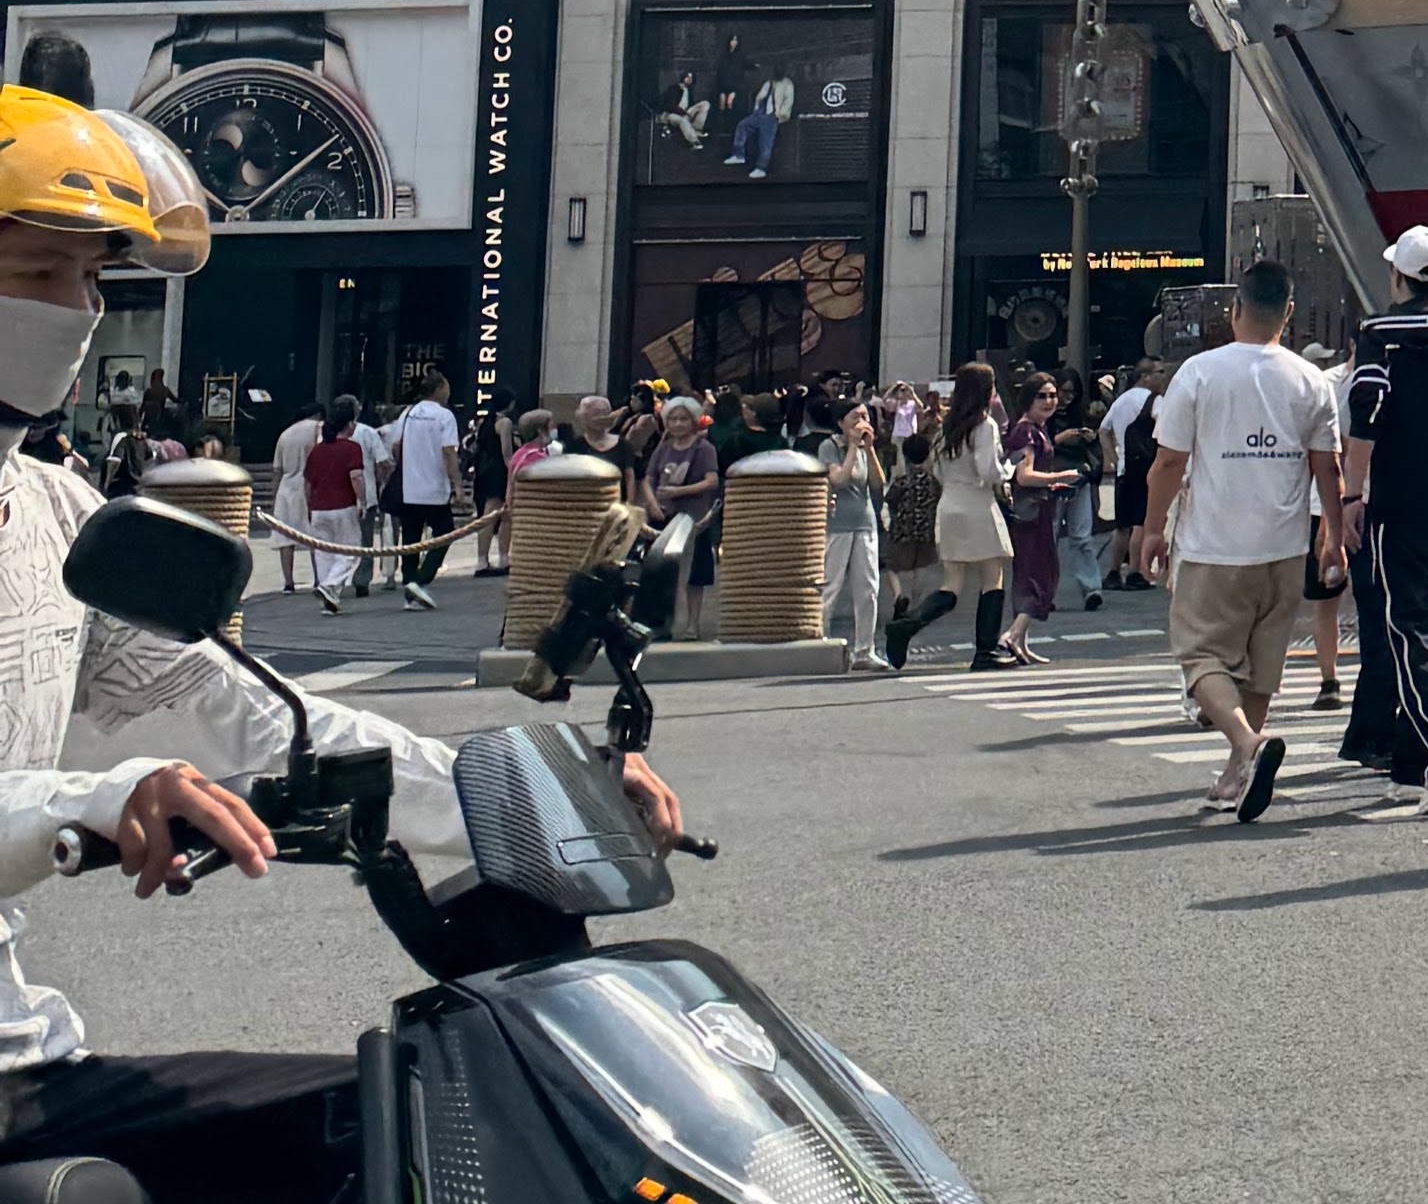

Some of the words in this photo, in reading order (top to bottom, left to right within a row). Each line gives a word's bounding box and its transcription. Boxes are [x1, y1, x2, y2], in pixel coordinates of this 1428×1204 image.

[493, 17, 514, 62] CO.
[488, 72, 511, 175] WATCH
[477, 188, 506, 416] TERNATIONAL
[1246, 425, 1277, 448] alo
